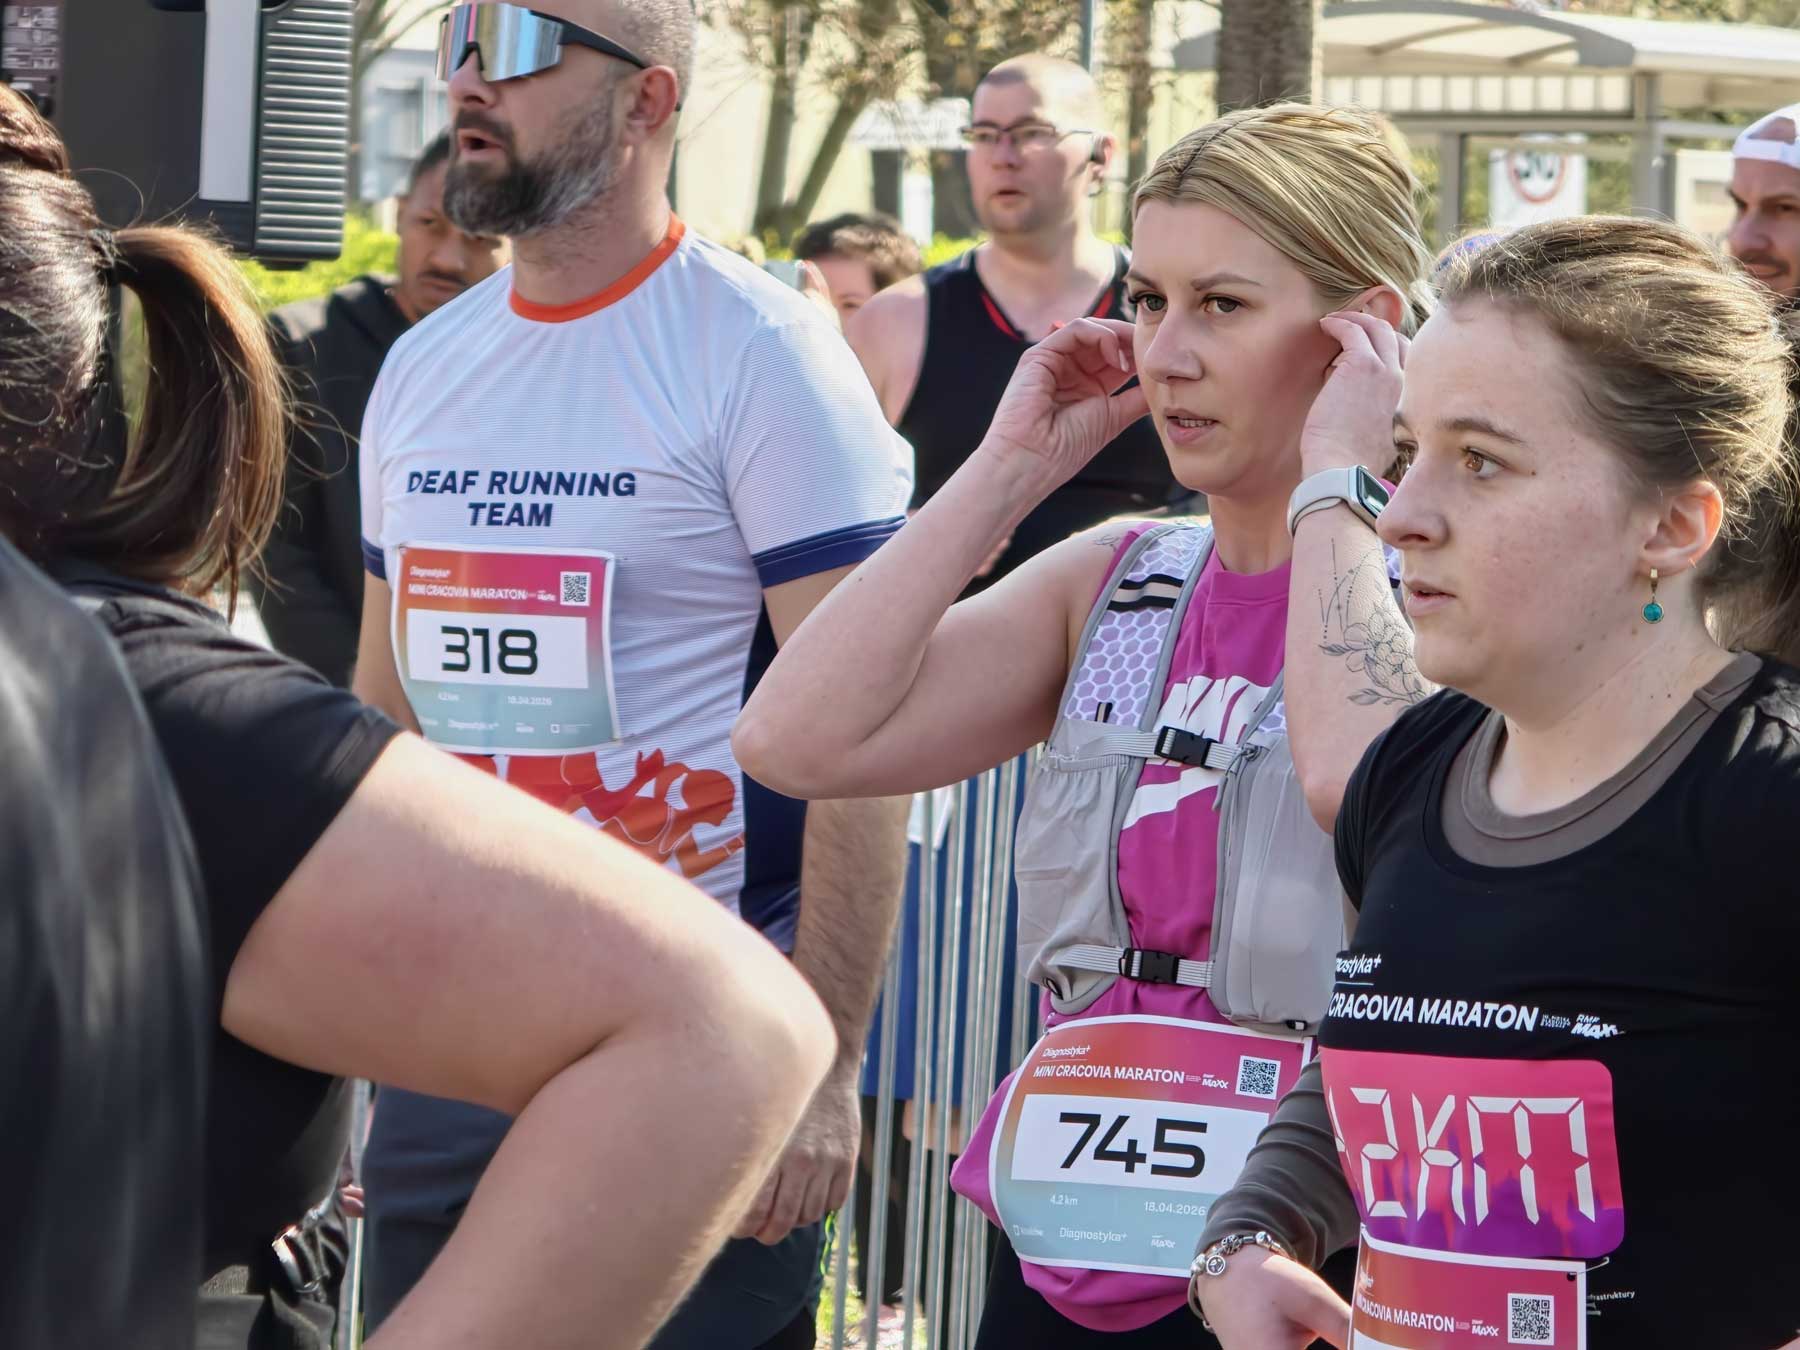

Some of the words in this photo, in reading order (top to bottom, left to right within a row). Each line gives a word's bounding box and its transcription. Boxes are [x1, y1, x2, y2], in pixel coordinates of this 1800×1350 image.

[407, 470, 479, 494] DEAF
[487, 470, 636, 496] RUNNING
[468, 502, 553, 527] TEAM
[470, 587, 527, 600] MARATON
[441, 625, 538, 676] 318
[1328, 992, 1414, 1023] CRACOVIA
[1418, 999, 1538, 1032] MARATON
[1043, 1044, 1091, 1059] Diagnostyka+
[1033, 1065, 1055, 1078] MINI
[1055, 1065, 1111, 1079] CRACOVIA
[1114, 1067, 1185, 1084] MARATON
[1058, 1112, 1208, 1178] 745
[1328, 1085, 1596, 1228] 2KM
[1144, 1201, 1207, 1216] 18.04.2026
[1059, 1227, 1127, 1243] Diagnostyka+
[1394, 1307, 1455, 1333] MARATON
